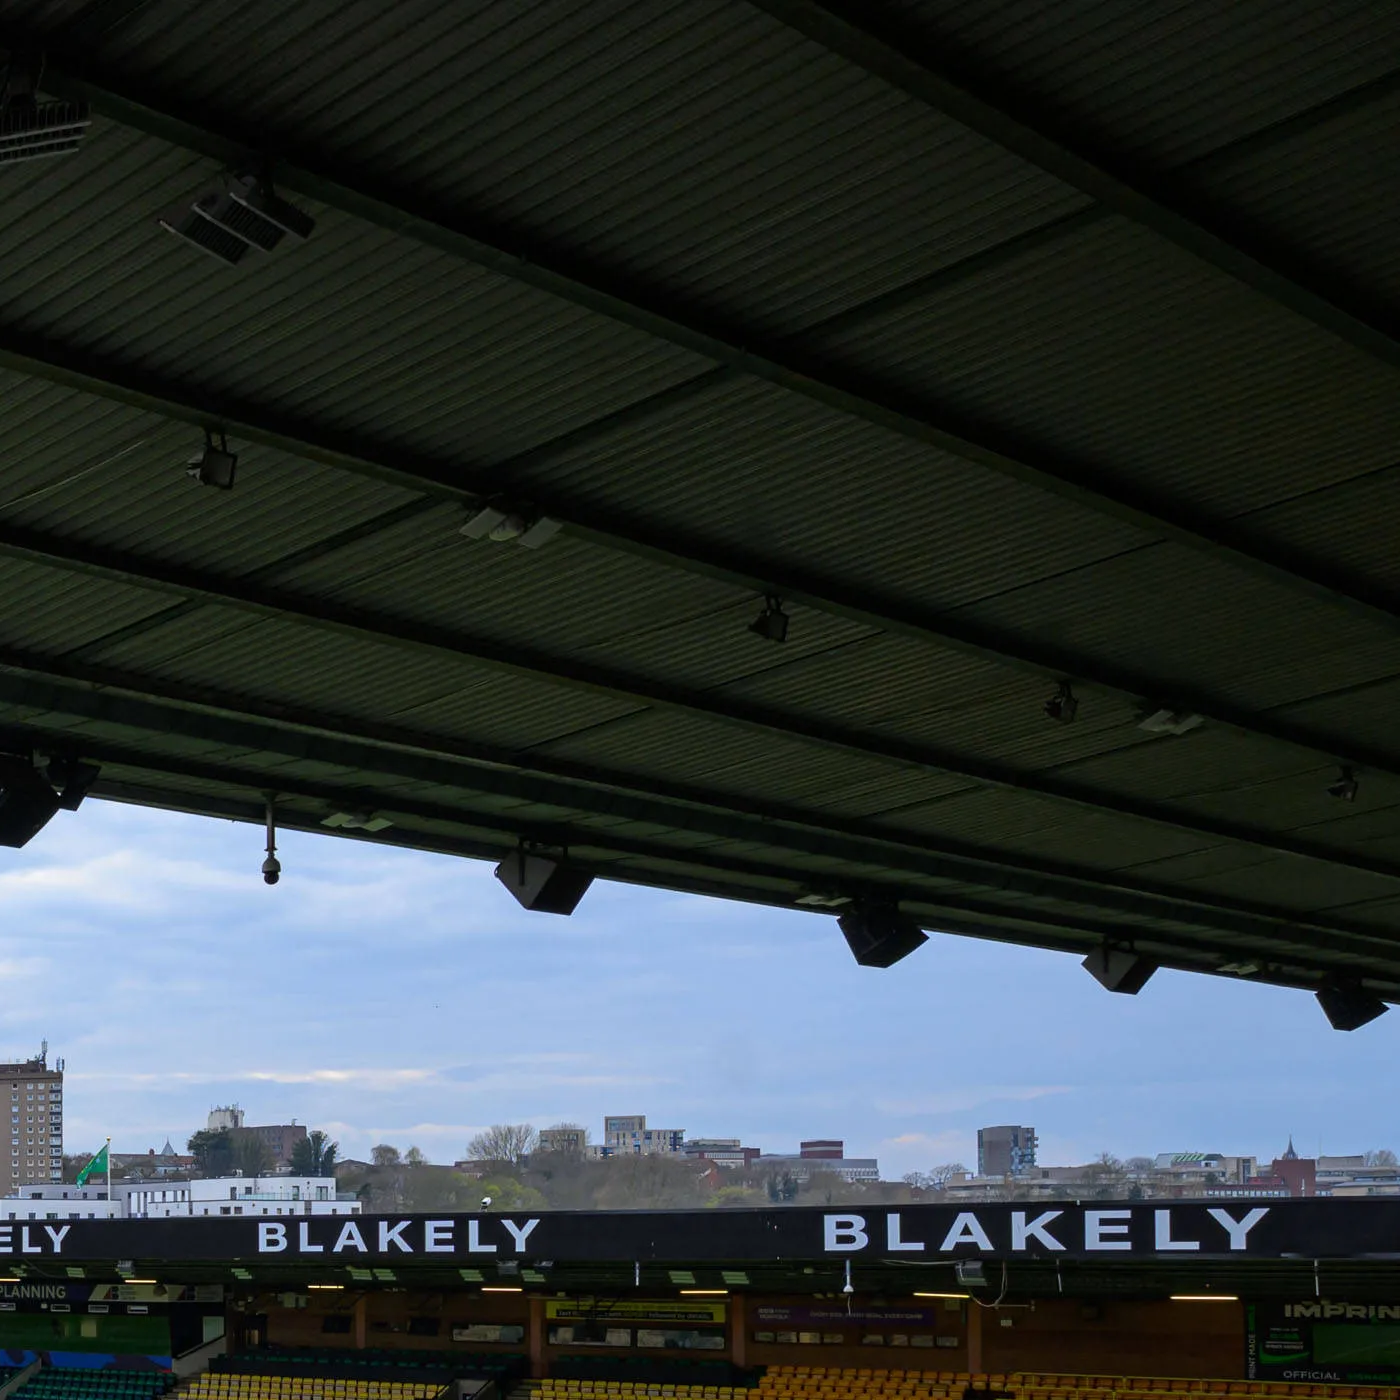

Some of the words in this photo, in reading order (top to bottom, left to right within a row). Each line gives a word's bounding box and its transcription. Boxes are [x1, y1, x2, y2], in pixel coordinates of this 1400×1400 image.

[258, 1218, 540, 1253] BLAKELY
[823, 1208, 1270, 1252] BLAKELY
[1283, 1370, 1341, 1381] OFFICIAL
